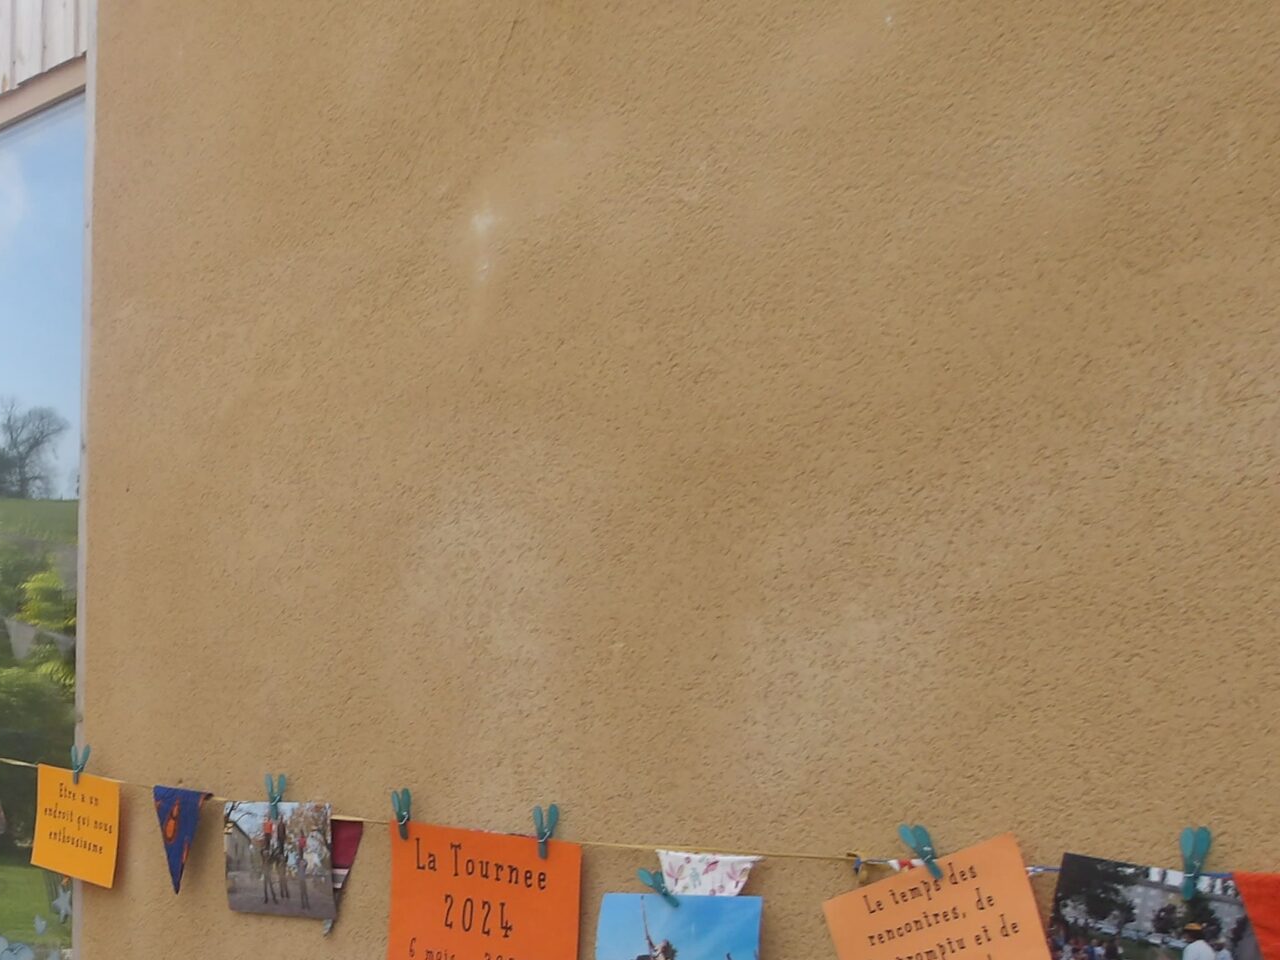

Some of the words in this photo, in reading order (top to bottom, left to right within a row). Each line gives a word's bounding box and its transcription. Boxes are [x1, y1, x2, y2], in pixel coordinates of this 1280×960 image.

[45, 803, 73, 822] endroit
[77, 816, 89, 830] qui
[94, 820, 112, 834] nous
[49, 827, 103, 854] enthousiasme
[415, 837, 437, 872] La
[450, 842, 547, 891] Tournee
[863, 895, 884, 914] Le
[889, 877, 942, 904] temps
[948, 862, 978, 885] des
[444, 893, 513, 939] 2024
[867, 907, 966, 946] rencontres,
[975, 887, 995, 911] de
[975, 925, 992, 945] et
[999, 914, 1020, 937] de
[409, 937, 416, 957] 6
